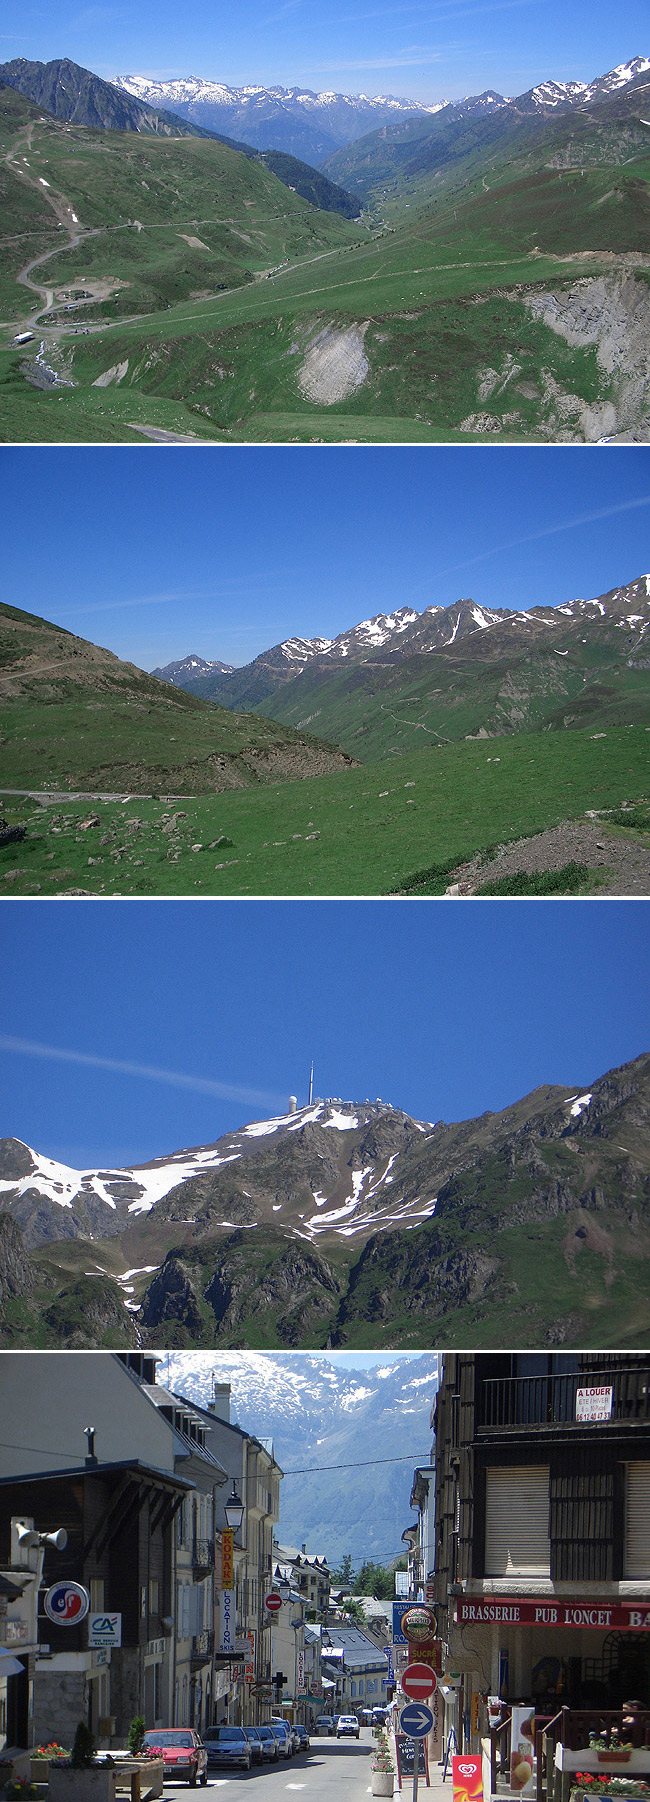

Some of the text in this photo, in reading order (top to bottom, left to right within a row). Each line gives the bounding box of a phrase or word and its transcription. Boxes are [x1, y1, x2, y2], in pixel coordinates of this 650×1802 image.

[585, 1388, 610, 1396] LOUER
[223, 1535, 232, 1579] KODAK
[461, 1605, 612, 1626] BRASSERIE PUB L'ONCET
[412, 1648, 437, 1658] SUCRÉ
